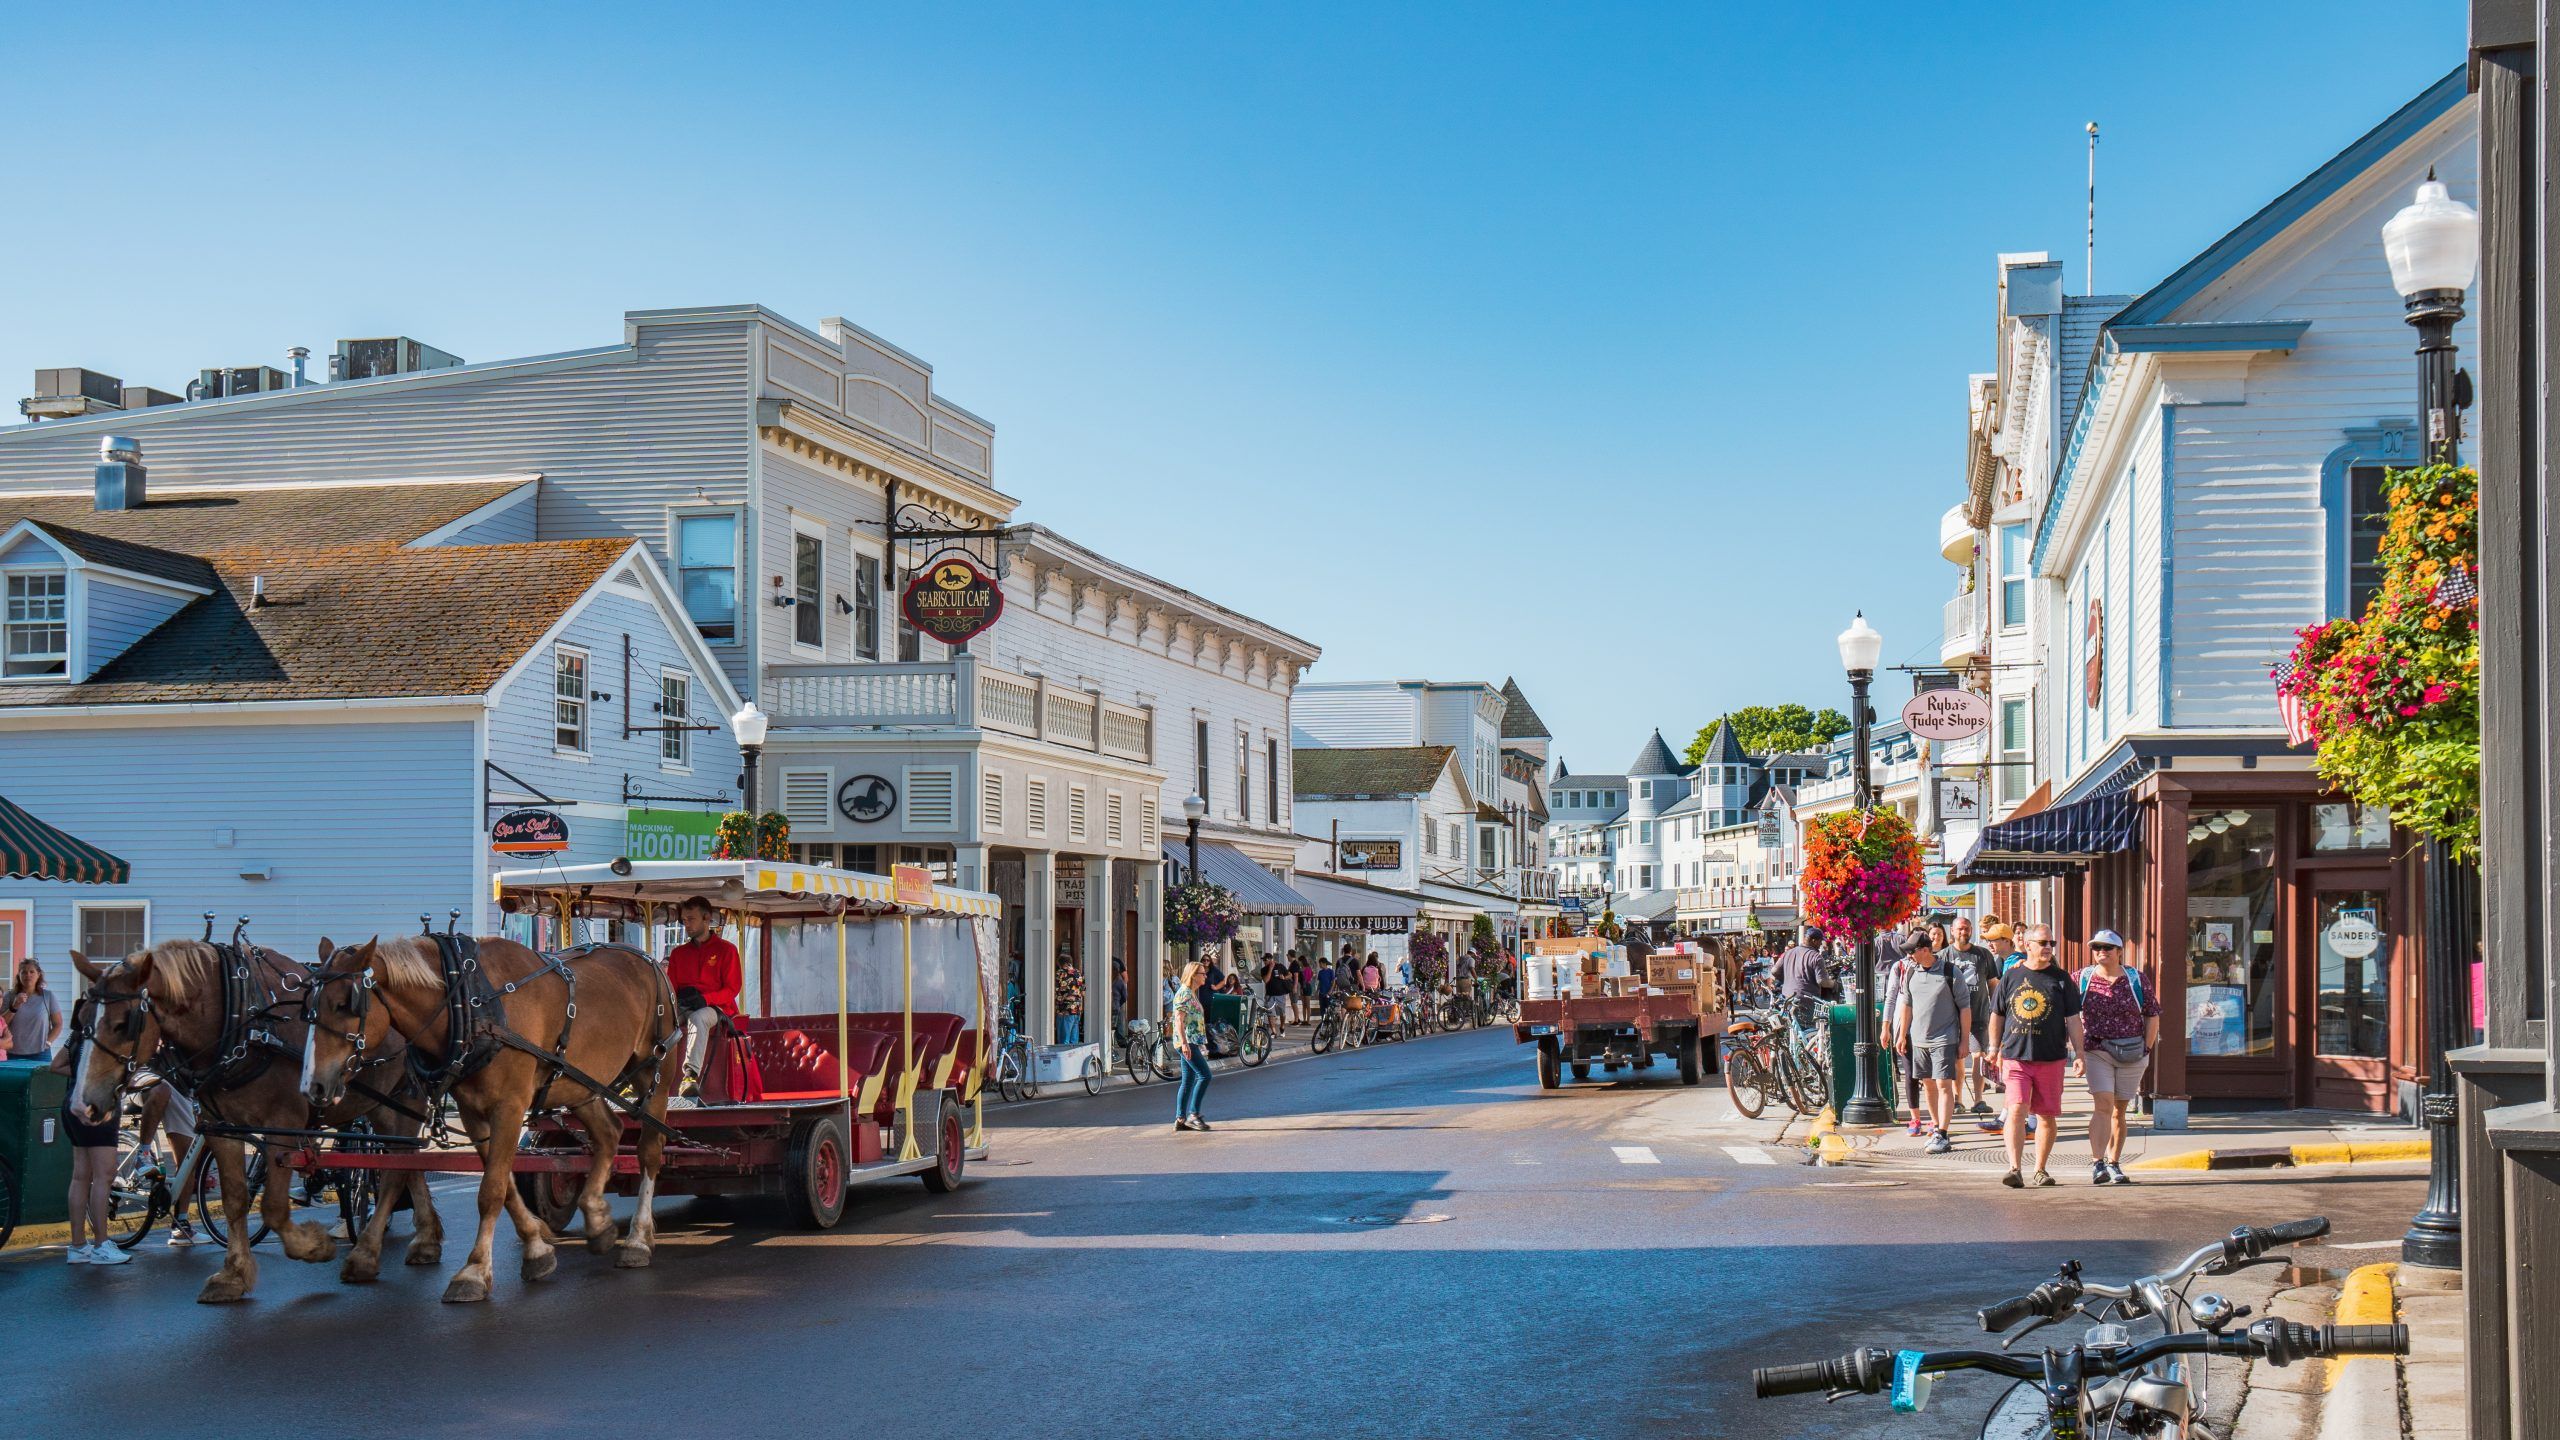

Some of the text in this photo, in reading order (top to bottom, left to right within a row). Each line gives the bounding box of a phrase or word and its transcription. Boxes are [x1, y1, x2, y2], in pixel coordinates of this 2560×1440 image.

[917, 587, 990, 608] SEABISCUIT CAFÉ
[1927, 695, 1967, 715] Ryba's
[1908, 712, 1985, 730] Fudge Shops
[525, 817, 551, 833] Sail
[629, 823, 674, 832] MACKINAC
[898, 876, 914, 893] Hotel
[1303, 917, 1403, 929] MURDICKS FUDGE
[2331, 932, 2377, 940] SANDERS
